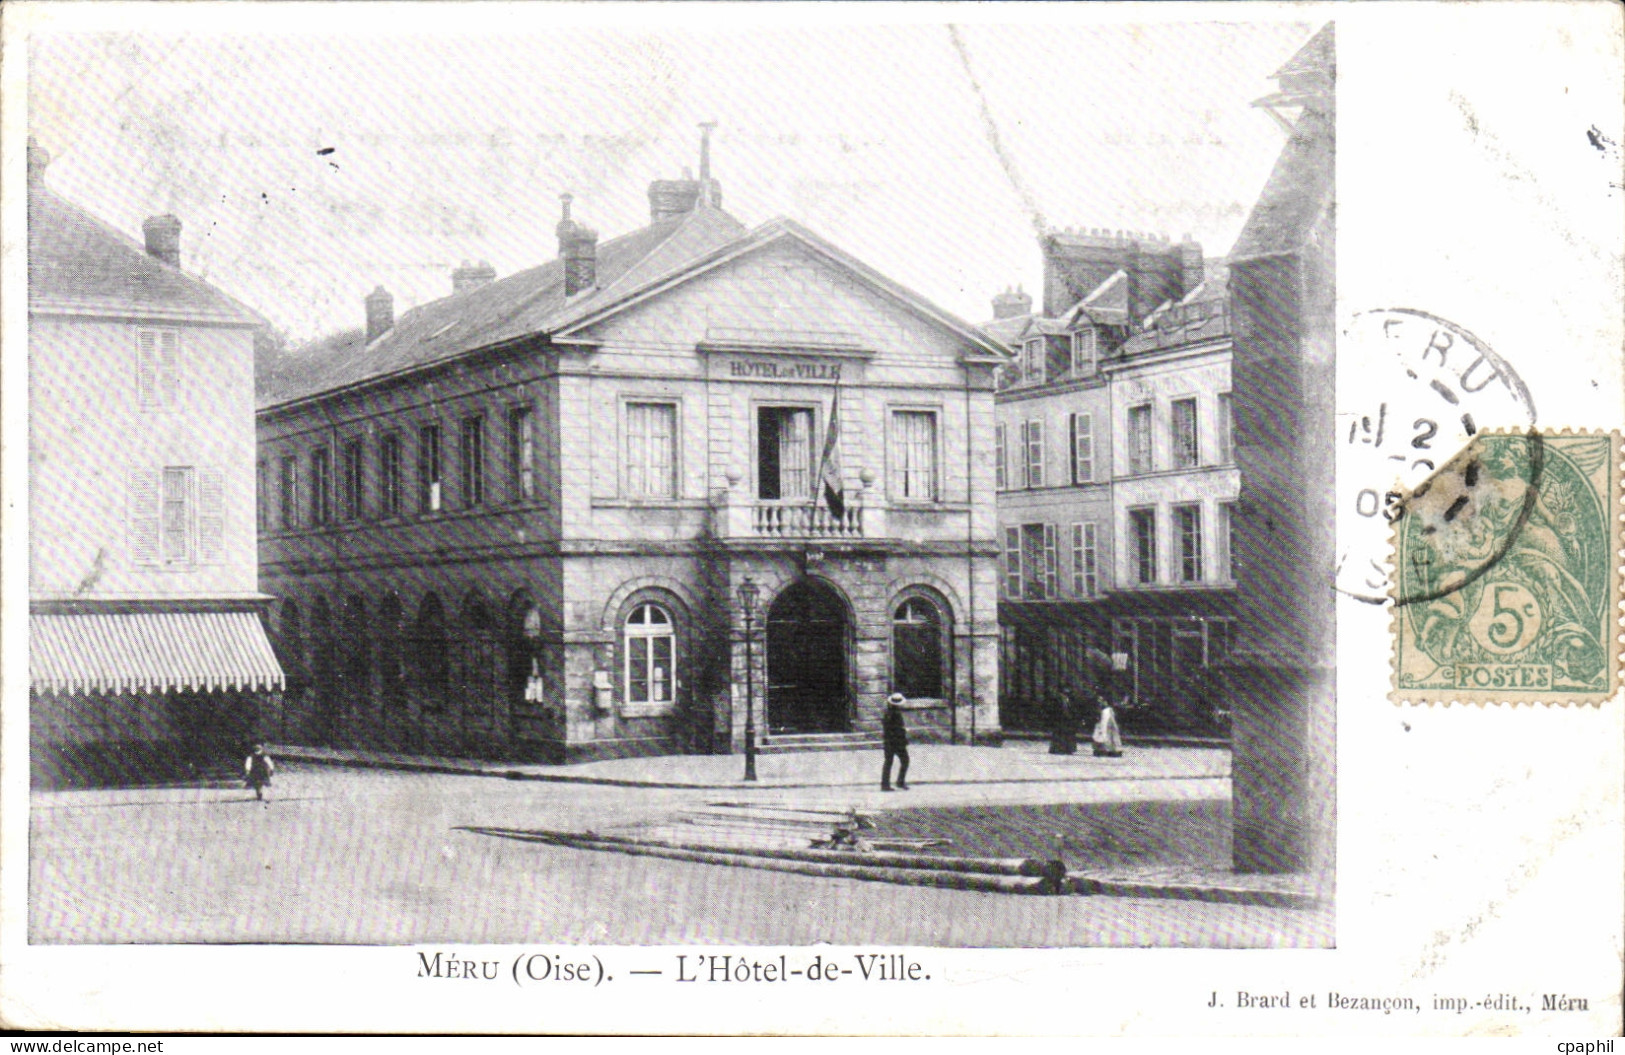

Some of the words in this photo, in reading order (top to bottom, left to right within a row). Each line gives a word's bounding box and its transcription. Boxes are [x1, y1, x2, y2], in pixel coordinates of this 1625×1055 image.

[1458, 664, 1549, 687] POSTES
[417, 952, 499, 980] MÉRU
[511, 953, 614, 986] (Oise).
[676, 953, 932, 983] L'Hôtel-de-Ville.
[1207, 991, 1225, 1008] J.
[1237, 991, 1291, 1008] Brard
[1299, 994, 1317, 1008] et
[1328, 992, 1421, 1015] Bezançon,
[1433, 993, 1532, 1015] imp.-édit.,
[1541, 994, 1589, 1012] Méru
